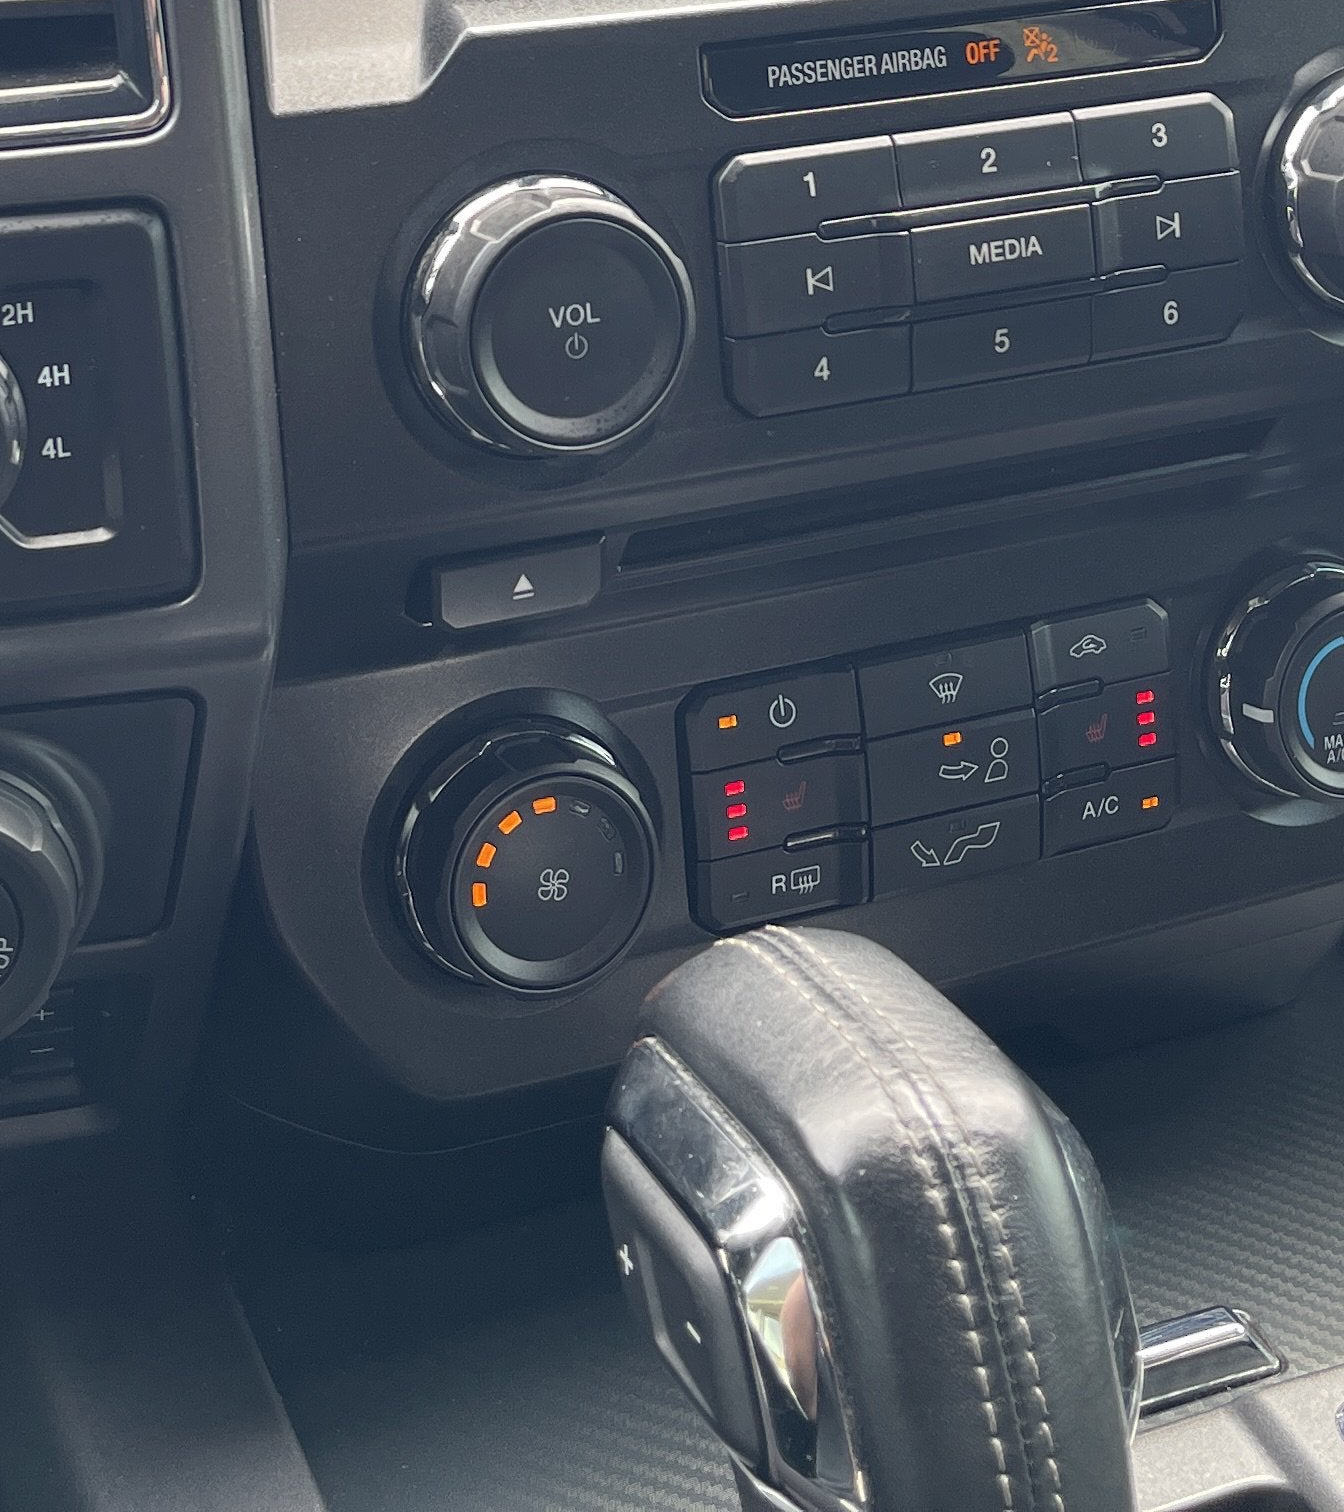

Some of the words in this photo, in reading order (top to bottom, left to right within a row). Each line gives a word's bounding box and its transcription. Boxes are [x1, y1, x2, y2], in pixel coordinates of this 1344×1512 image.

[766, 53, 878, 89] PASSENGER
[879, 45, 948, 76] AIRBAG
[964, 39, 1001, 66] OFF
[1151, 122, 1169, 149] 3
[980, 147, 998, 174] 2
[802, 171, 817, 197] 1
[969, 235, 1044, 266] MEDIA
[1, 300, 35, 327] 2H
[548, 301, 602, 329] VOL
[1163, 299, 1180, 326] 6
[993, 328, 1011, 355] 5
[37, 363, 72, 388] 4H
[812, 356, 832, 382] 4
[40, 437, 72, 460] 4L
[1081, 795, 1120, 821] A/C
[771, 874, 788, 895] R
